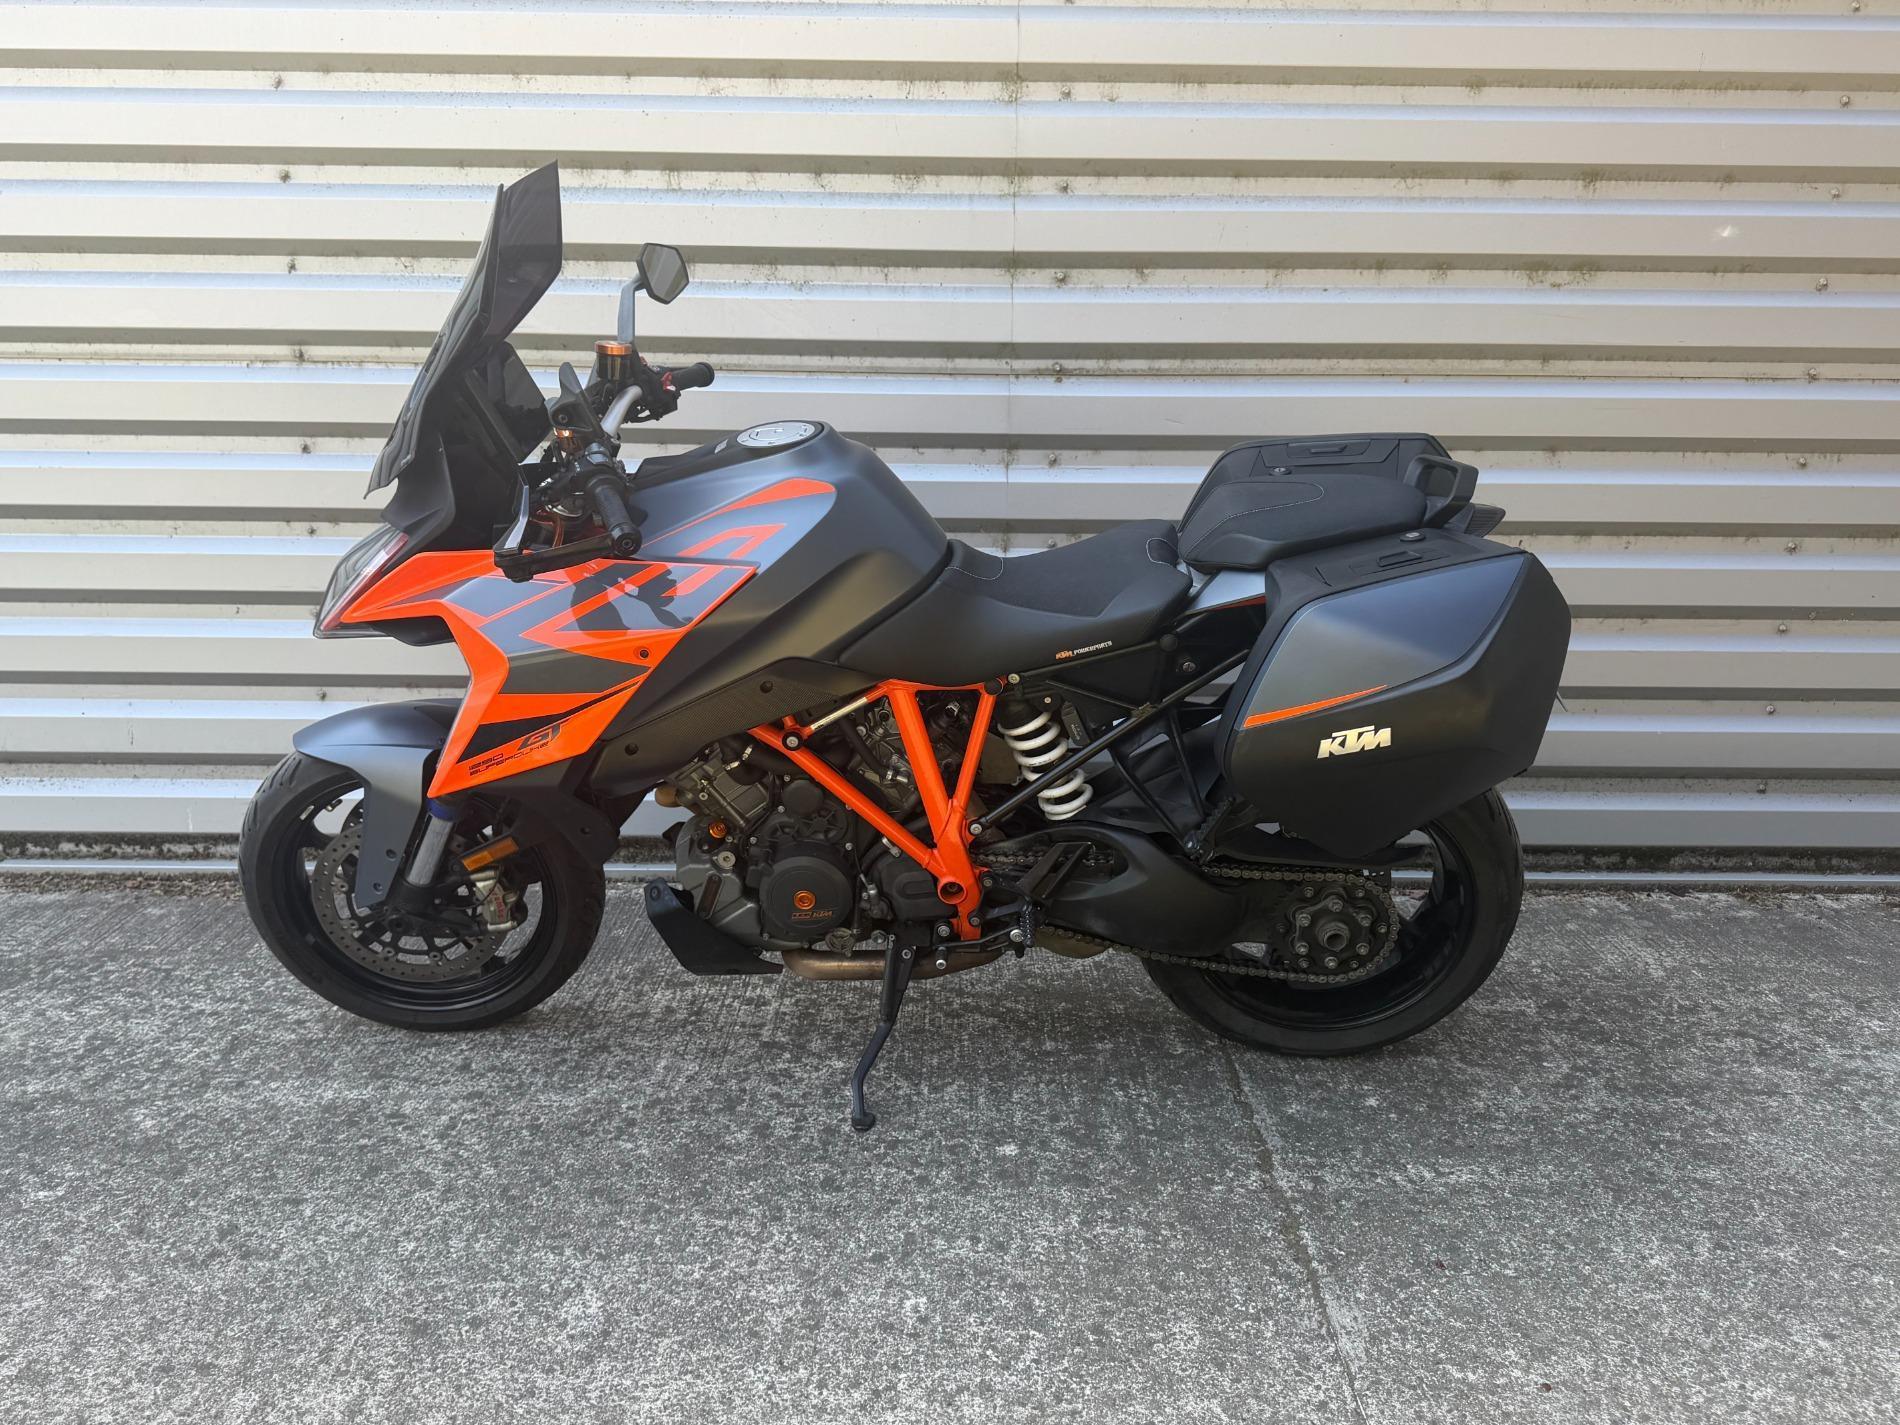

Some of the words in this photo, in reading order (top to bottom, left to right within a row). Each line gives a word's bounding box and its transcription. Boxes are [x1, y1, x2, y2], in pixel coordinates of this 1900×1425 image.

[1056, 650, 1073, 660] KTM
[1073, 640, 1113, 656] POWERPARTS
[517, 719, 570, 751] GT
[1317, 725, 1392, 759] KTM
